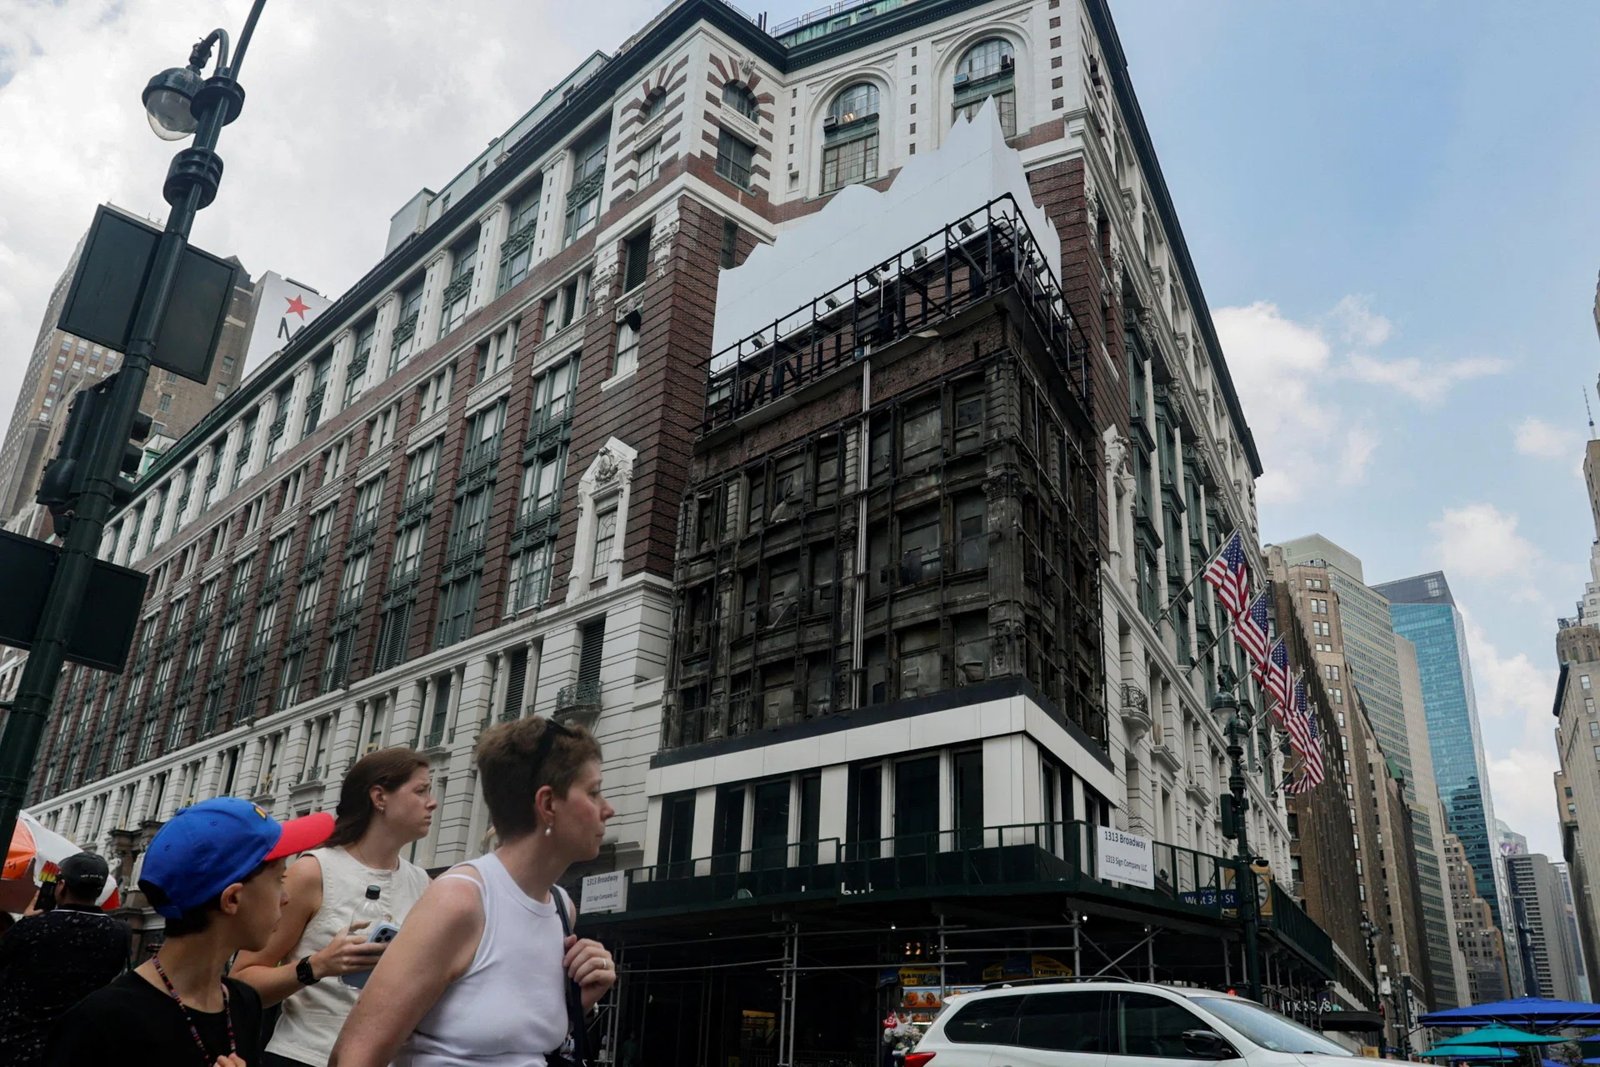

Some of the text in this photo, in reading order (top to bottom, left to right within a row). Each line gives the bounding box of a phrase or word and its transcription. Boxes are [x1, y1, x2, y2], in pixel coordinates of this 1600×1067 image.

[1105, 831, 1146, 851] 1313 Broadway
[1105, 855, 1115, 864] 1313
[1115, 857, 1124, 867] Sign
[1124, 859, 1141, 872] Company
[587, 875, 618, 886] 1313 Broadway
[1225, 893, 1235, 903] St
